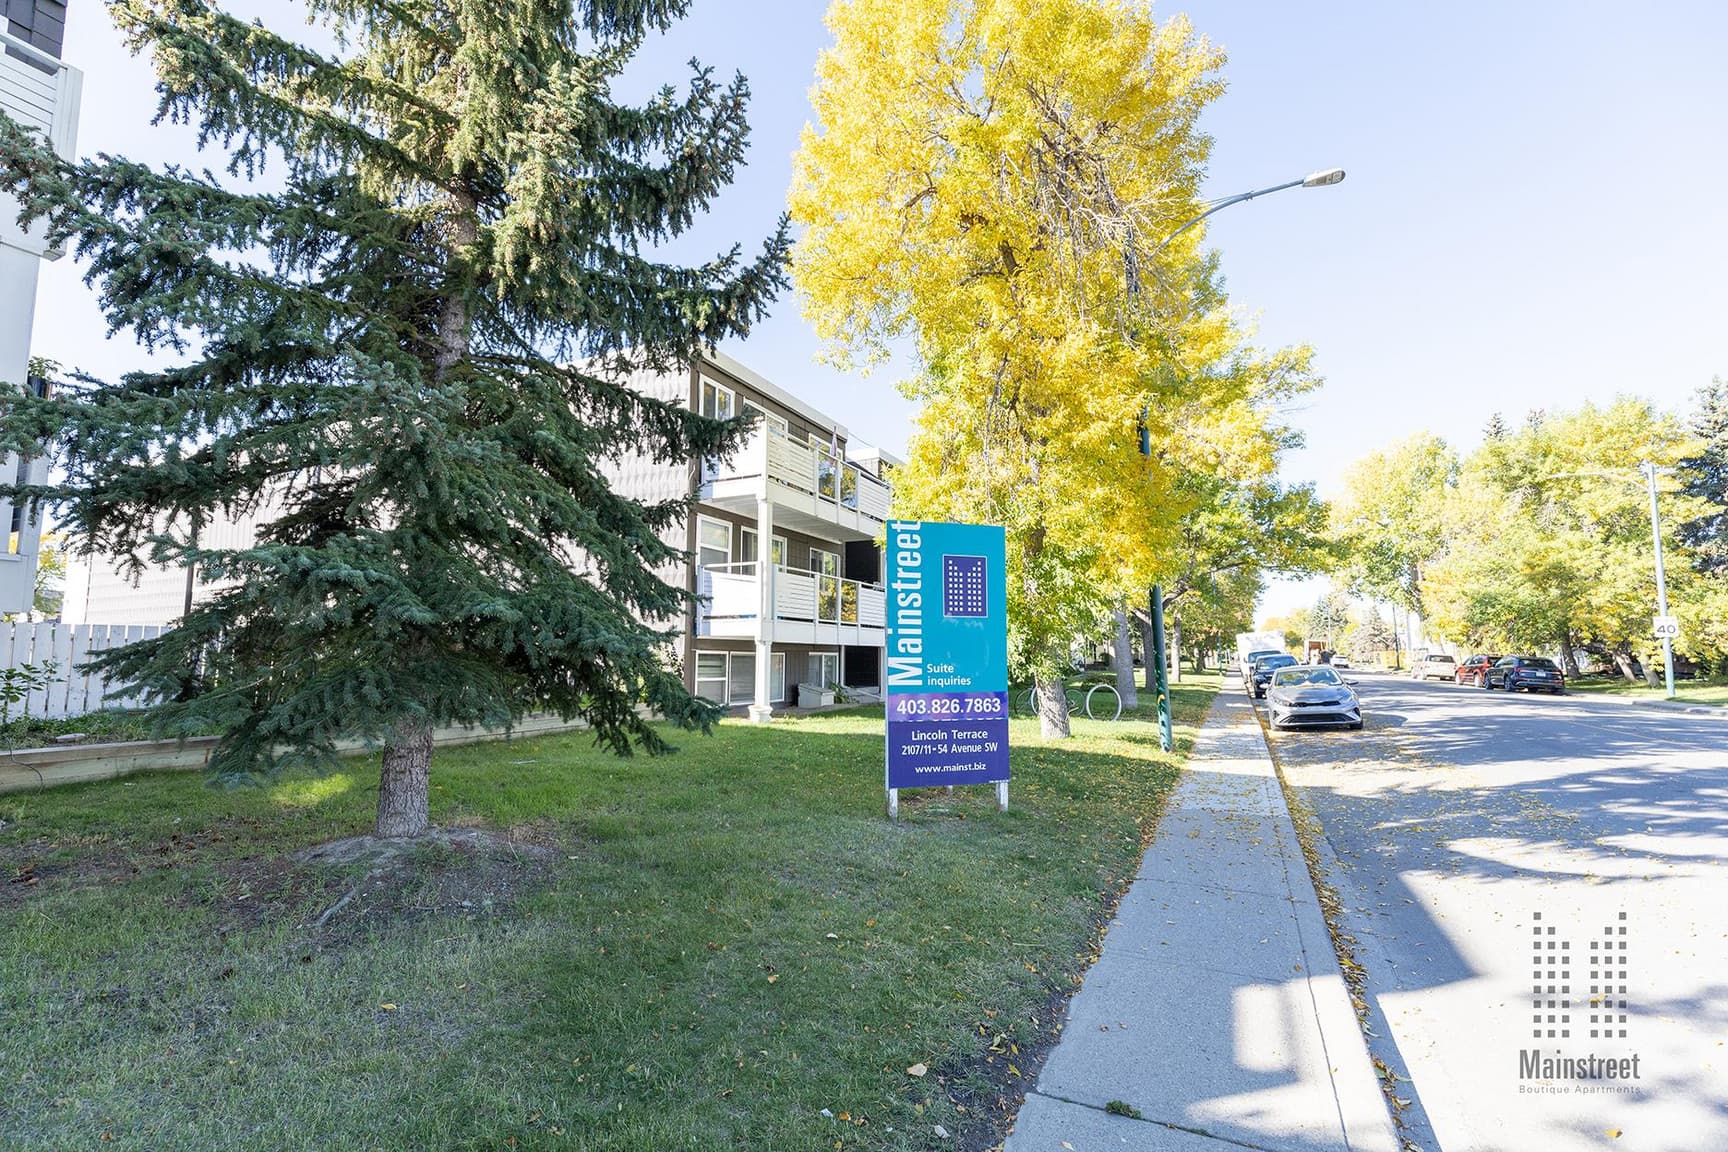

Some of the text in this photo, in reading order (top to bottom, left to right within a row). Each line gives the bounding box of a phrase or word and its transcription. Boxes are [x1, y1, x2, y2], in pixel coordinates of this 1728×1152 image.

[888, 520, 923, 687] Mainstreet
[1656, 625, 1676, 634] 40
[927, 663, 954, 673] Suite
[927, 675, 972, 688] inquiries
[896, 697, 1001, 715] 403.826.7863
[911, 729, 988, 741] Lincoln Terrace
[951, 743, 982, 754] Avenue
[984, 742, 999, 753] SW
[914, 762, 987, 774] www.mainst.biz
